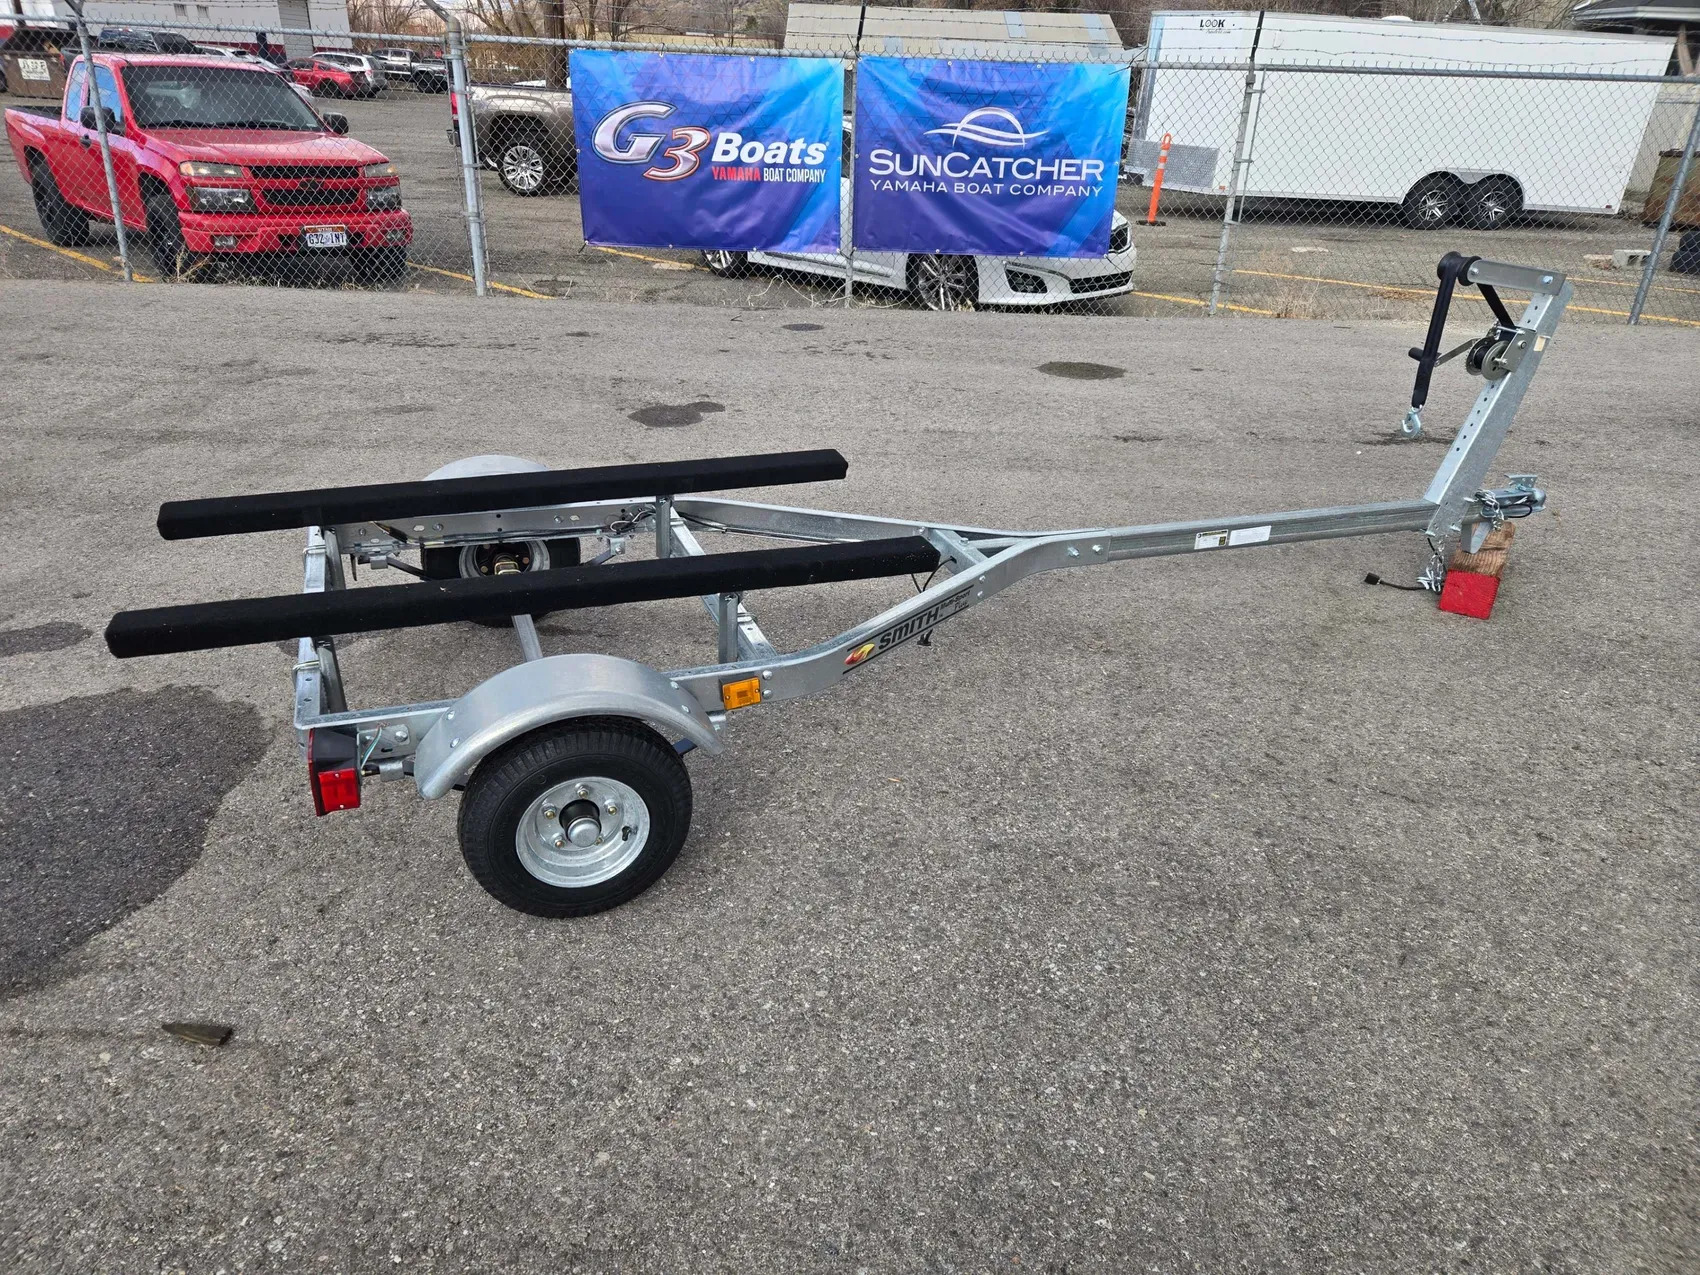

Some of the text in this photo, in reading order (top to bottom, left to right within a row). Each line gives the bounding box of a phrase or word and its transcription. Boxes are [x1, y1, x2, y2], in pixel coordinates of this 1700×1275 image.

[1200, 19, 1226, 28] LOOK
[592, 101, 827, 182] G3 Boats
[712, 166, 826, 183] YAMAHA BOAT COMPANY
[870, 179, 1104, 197] YAMAHA BOAT COMPANY
